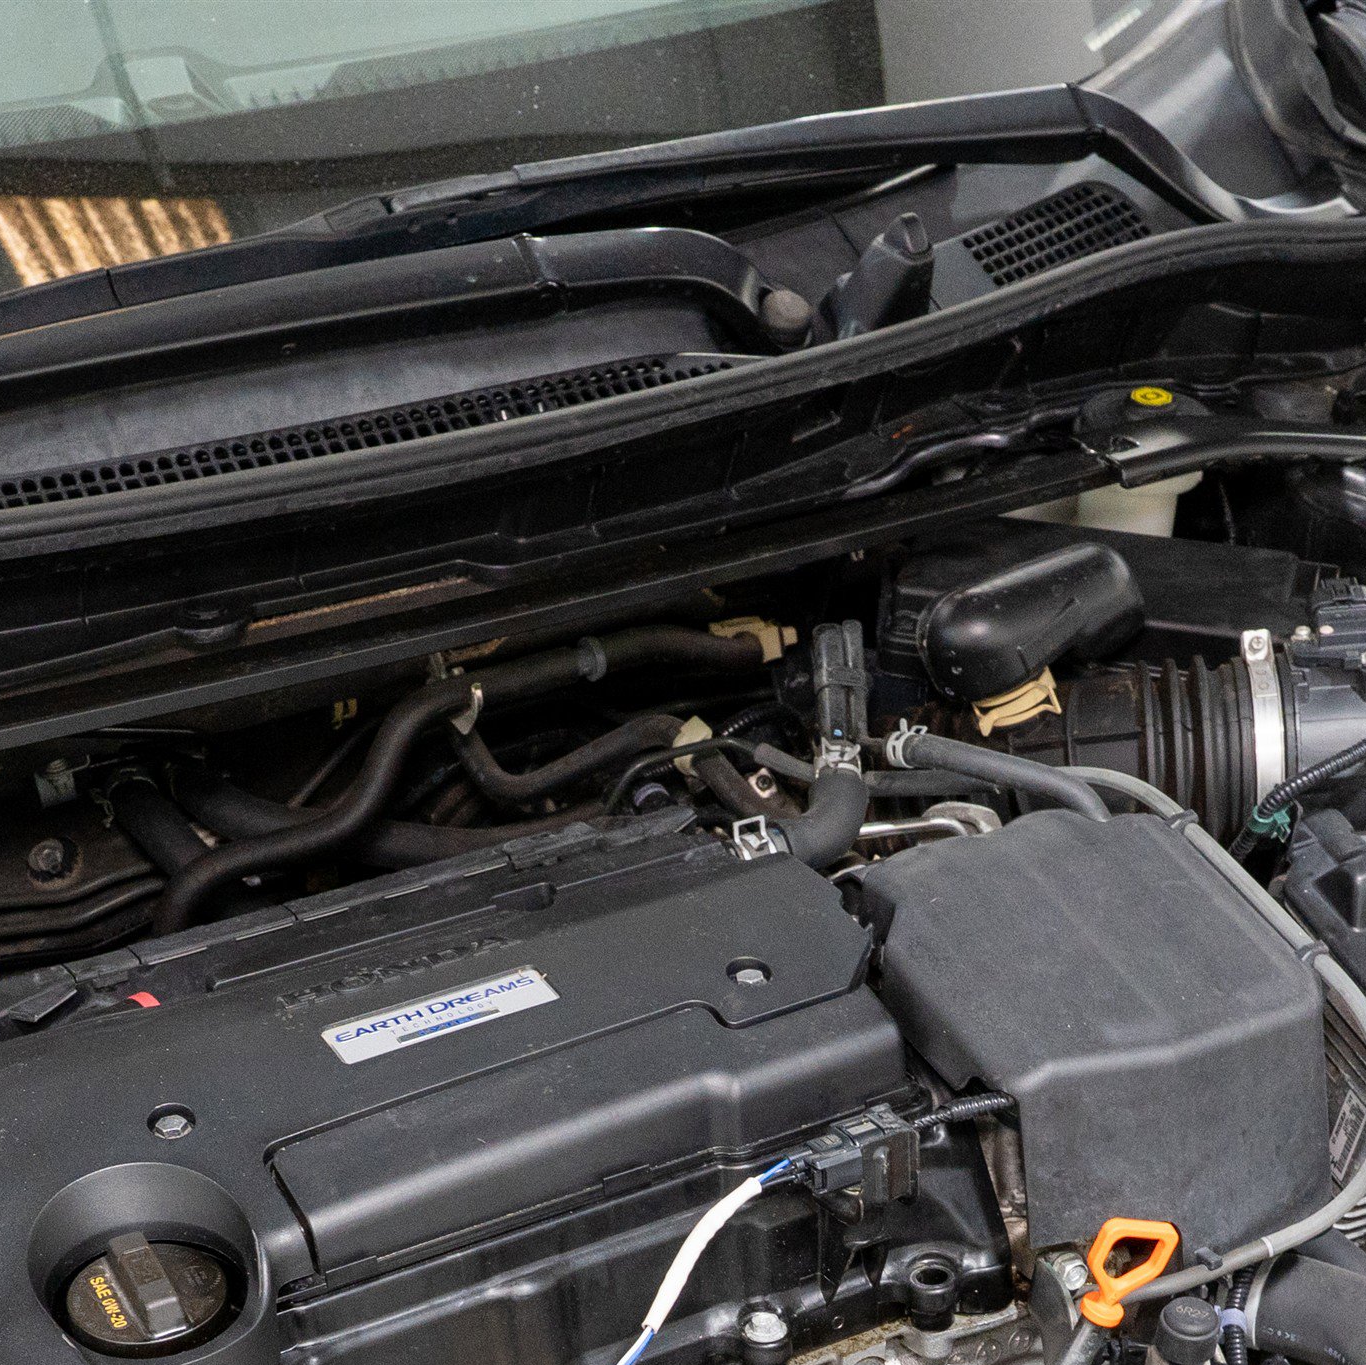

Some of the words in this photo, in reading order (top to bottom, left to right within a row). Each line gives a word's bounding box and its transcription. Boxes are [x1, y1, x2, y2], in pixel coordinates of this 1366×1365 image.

[277, 935, 519, 1010] HONDA
[335, 1010, 424, 1043] EARTH
[427, 975, 535, 1015] DREAMS
[389, 1000, 495, 1036] TECHNOLOGY
[89, 1276, 109, 1299] SAE
[102, 1294, 128, 1329] 0W-20
